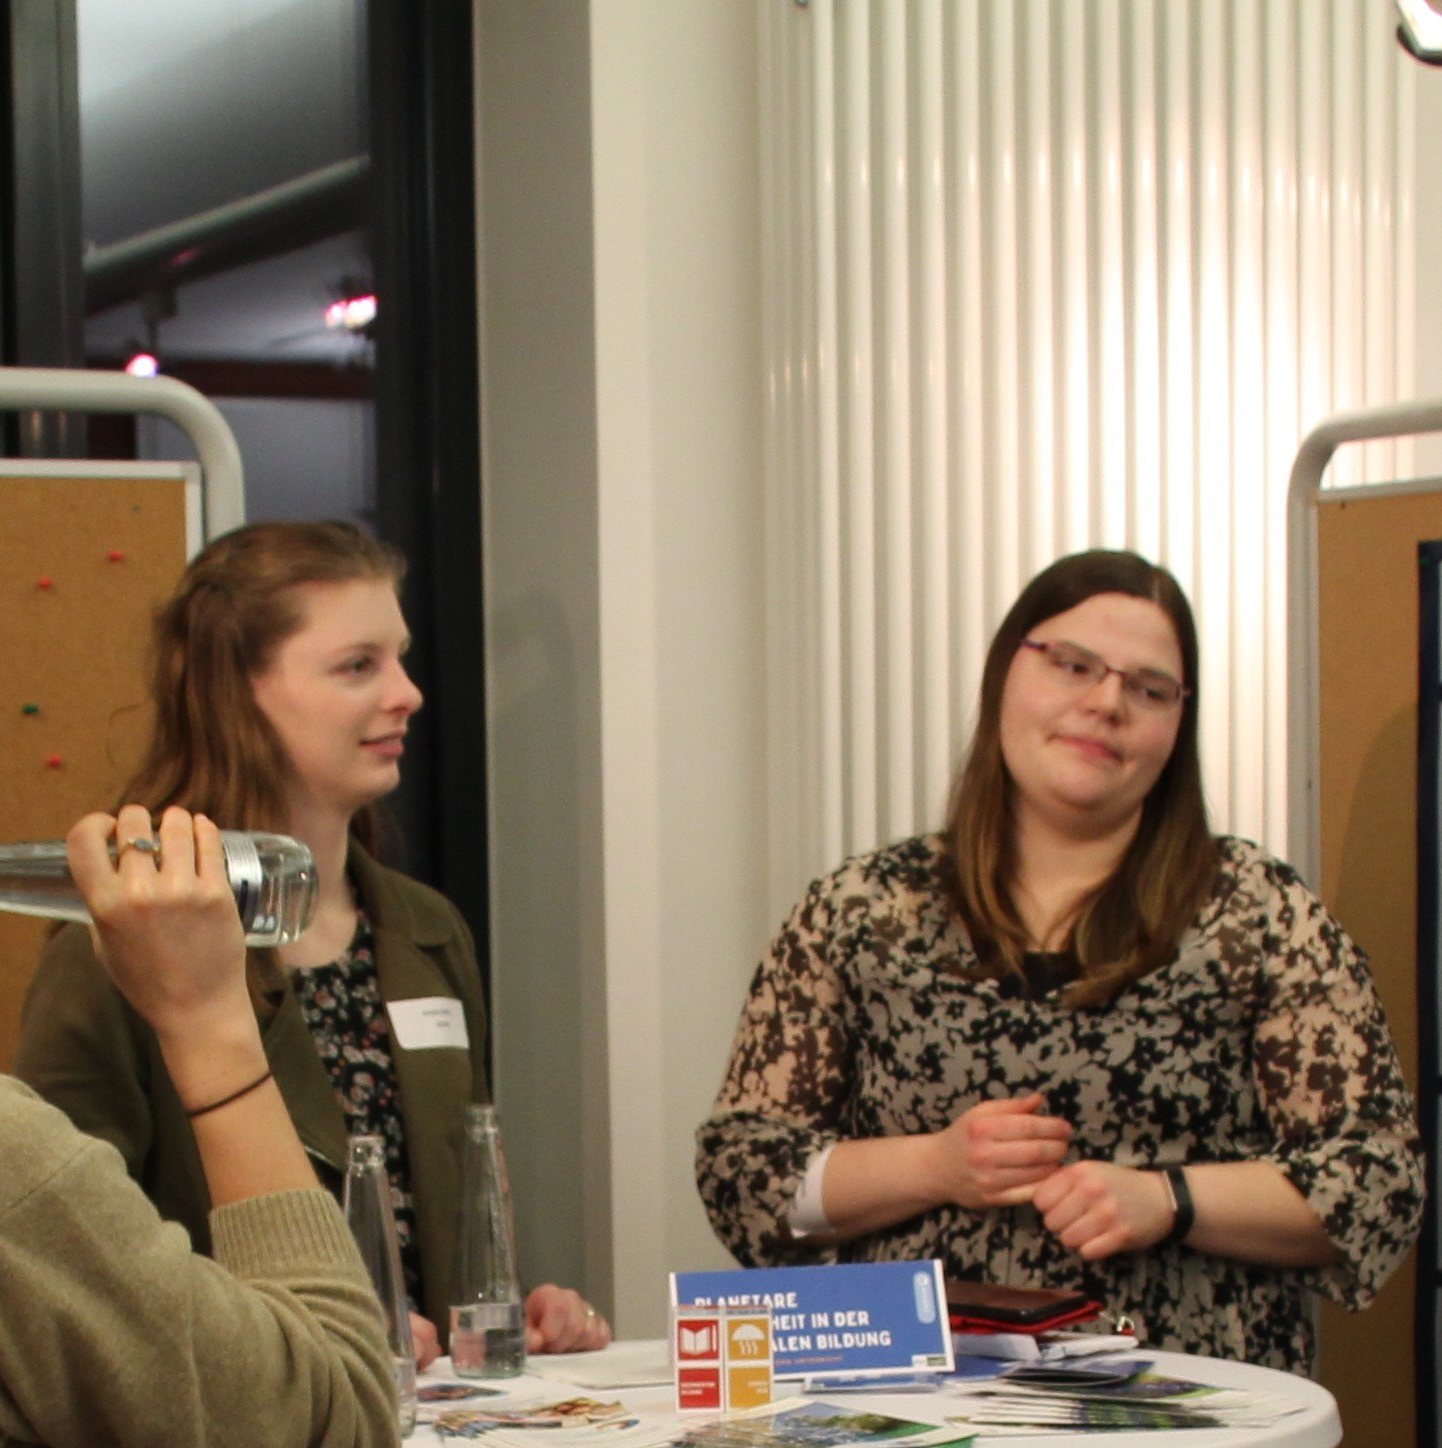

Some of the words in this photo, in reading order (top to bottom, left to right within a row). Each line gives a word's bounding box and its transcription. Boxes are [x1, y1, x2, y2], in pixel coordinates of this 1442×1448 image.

[811, 1312, 830, 1328] IN
[834, 1310, 870, 1327] DER
[816, 1330, 892, 1350] BILDUNG
